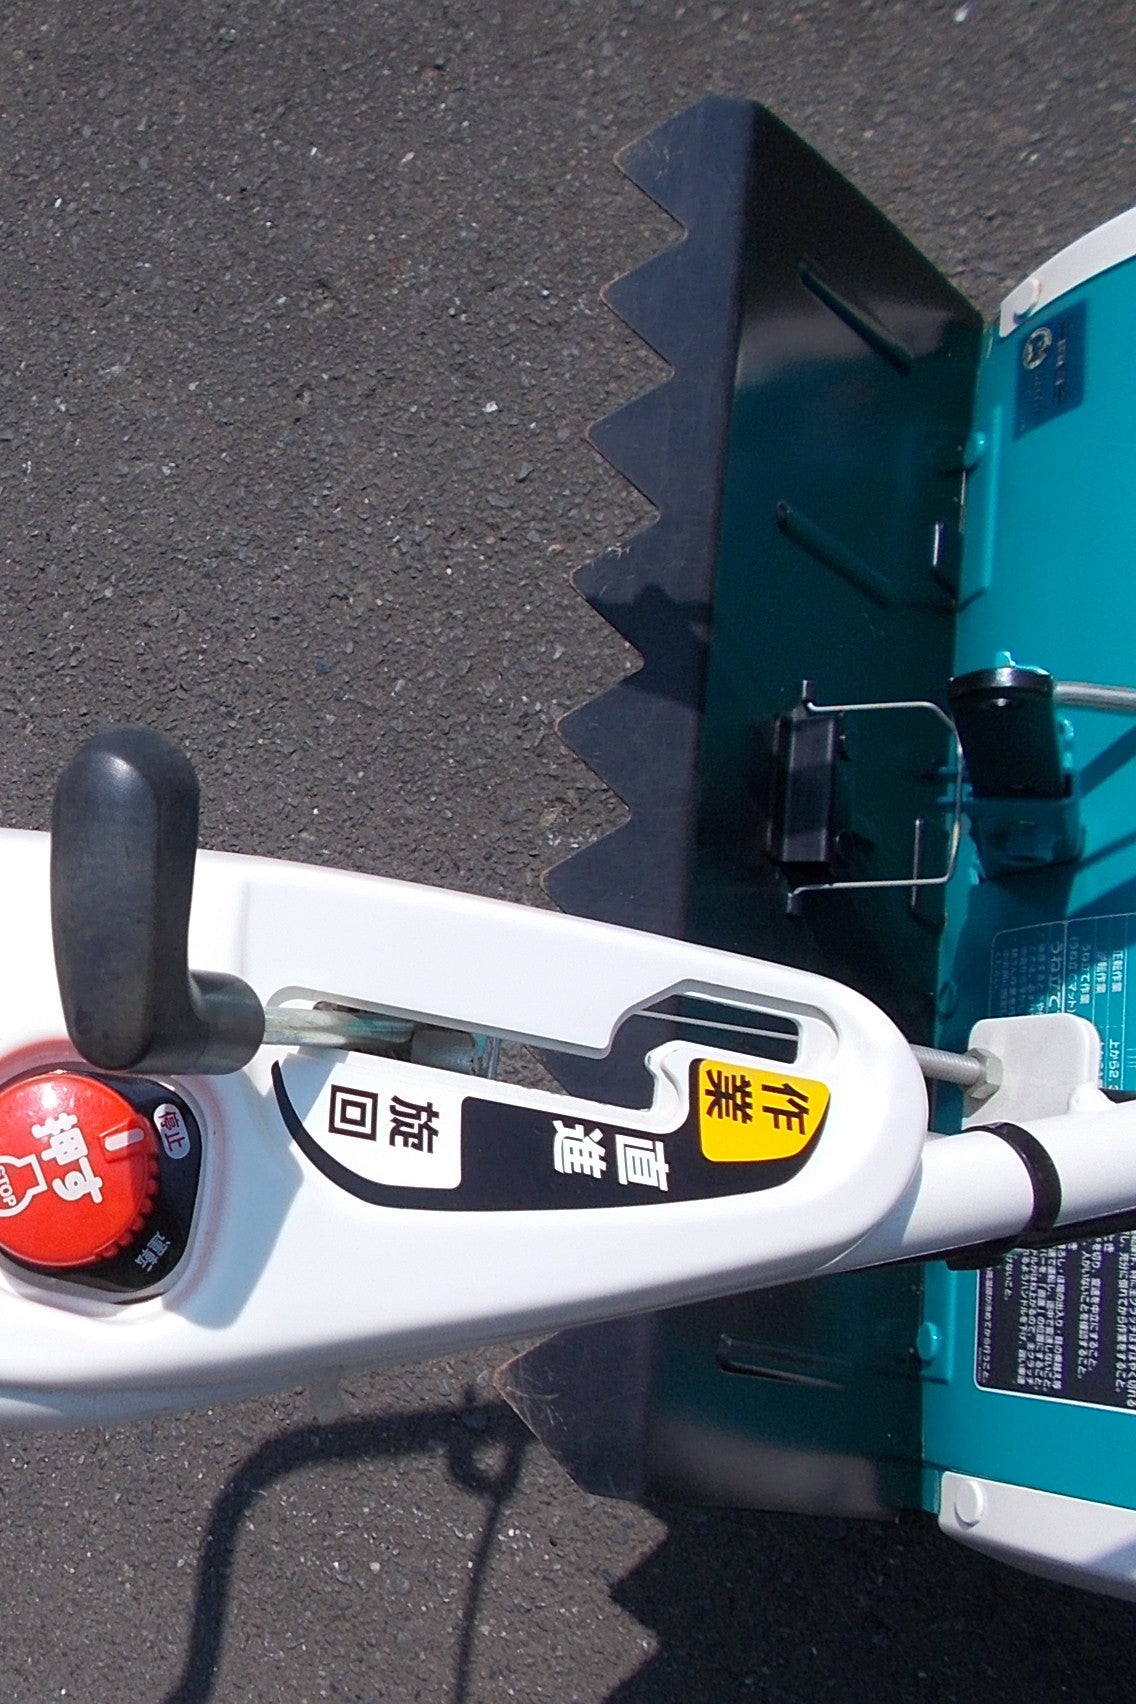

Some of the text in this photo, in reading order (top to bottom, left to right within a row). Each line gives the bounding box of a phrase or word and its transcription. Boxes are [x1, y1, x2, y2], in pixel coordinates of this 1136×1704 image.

[1048, 940, 1063, 1014] うね立て
[158, 1110, 185, 1152] 停止
[327, 1083, 440, 1155] 旋回
[704, 1068, 812, 1136] 作業
[30, 1111, 106, 1205] 押す
[552, 1119, 670, 1193] 直進
[134, 1231, 172, 1273] 運転
